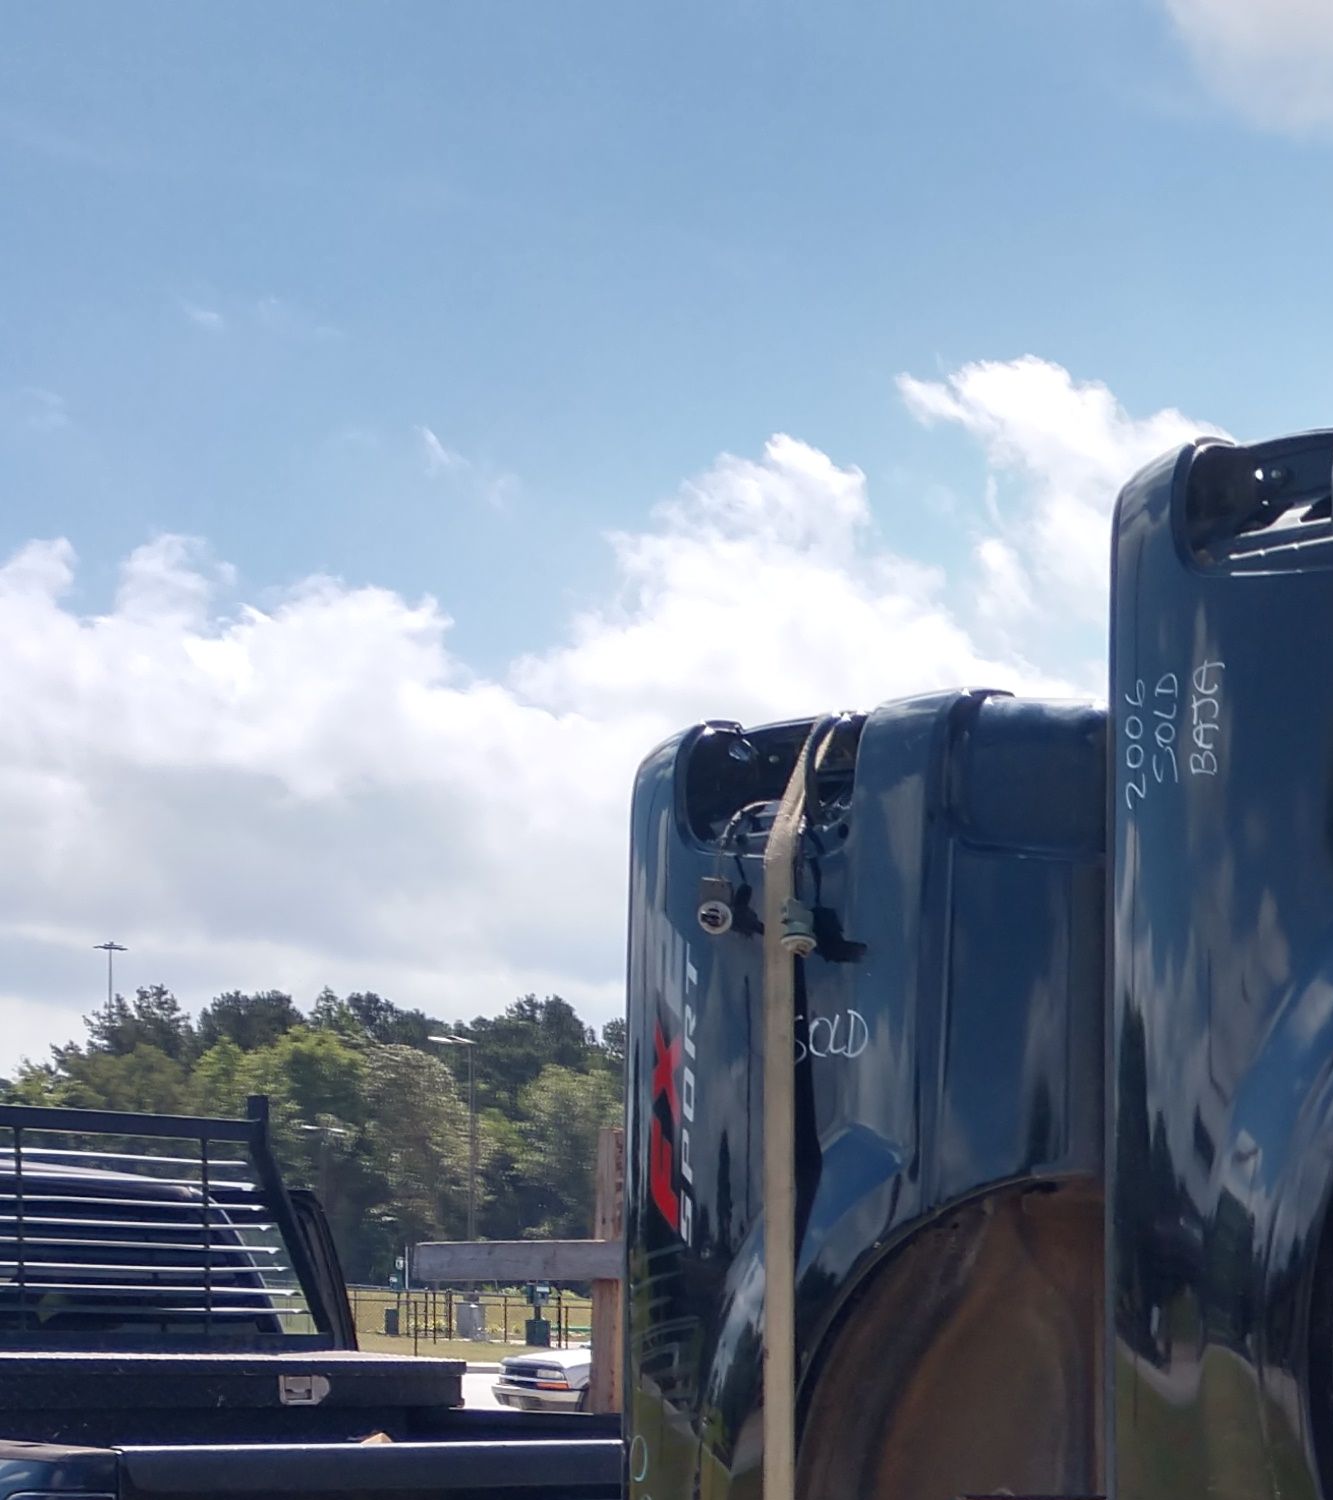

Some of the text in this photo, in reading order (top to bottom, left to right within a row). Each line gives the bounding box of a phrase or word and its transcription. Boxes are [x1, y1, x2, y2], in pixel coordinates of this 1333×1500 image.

[1125, 679, 1146, 810] 2006
[1152, 672, 1178, 783] SOLD
[1189, 660, 1226, 776] BAJA
[679, 942, 698, 1248] SPORT
